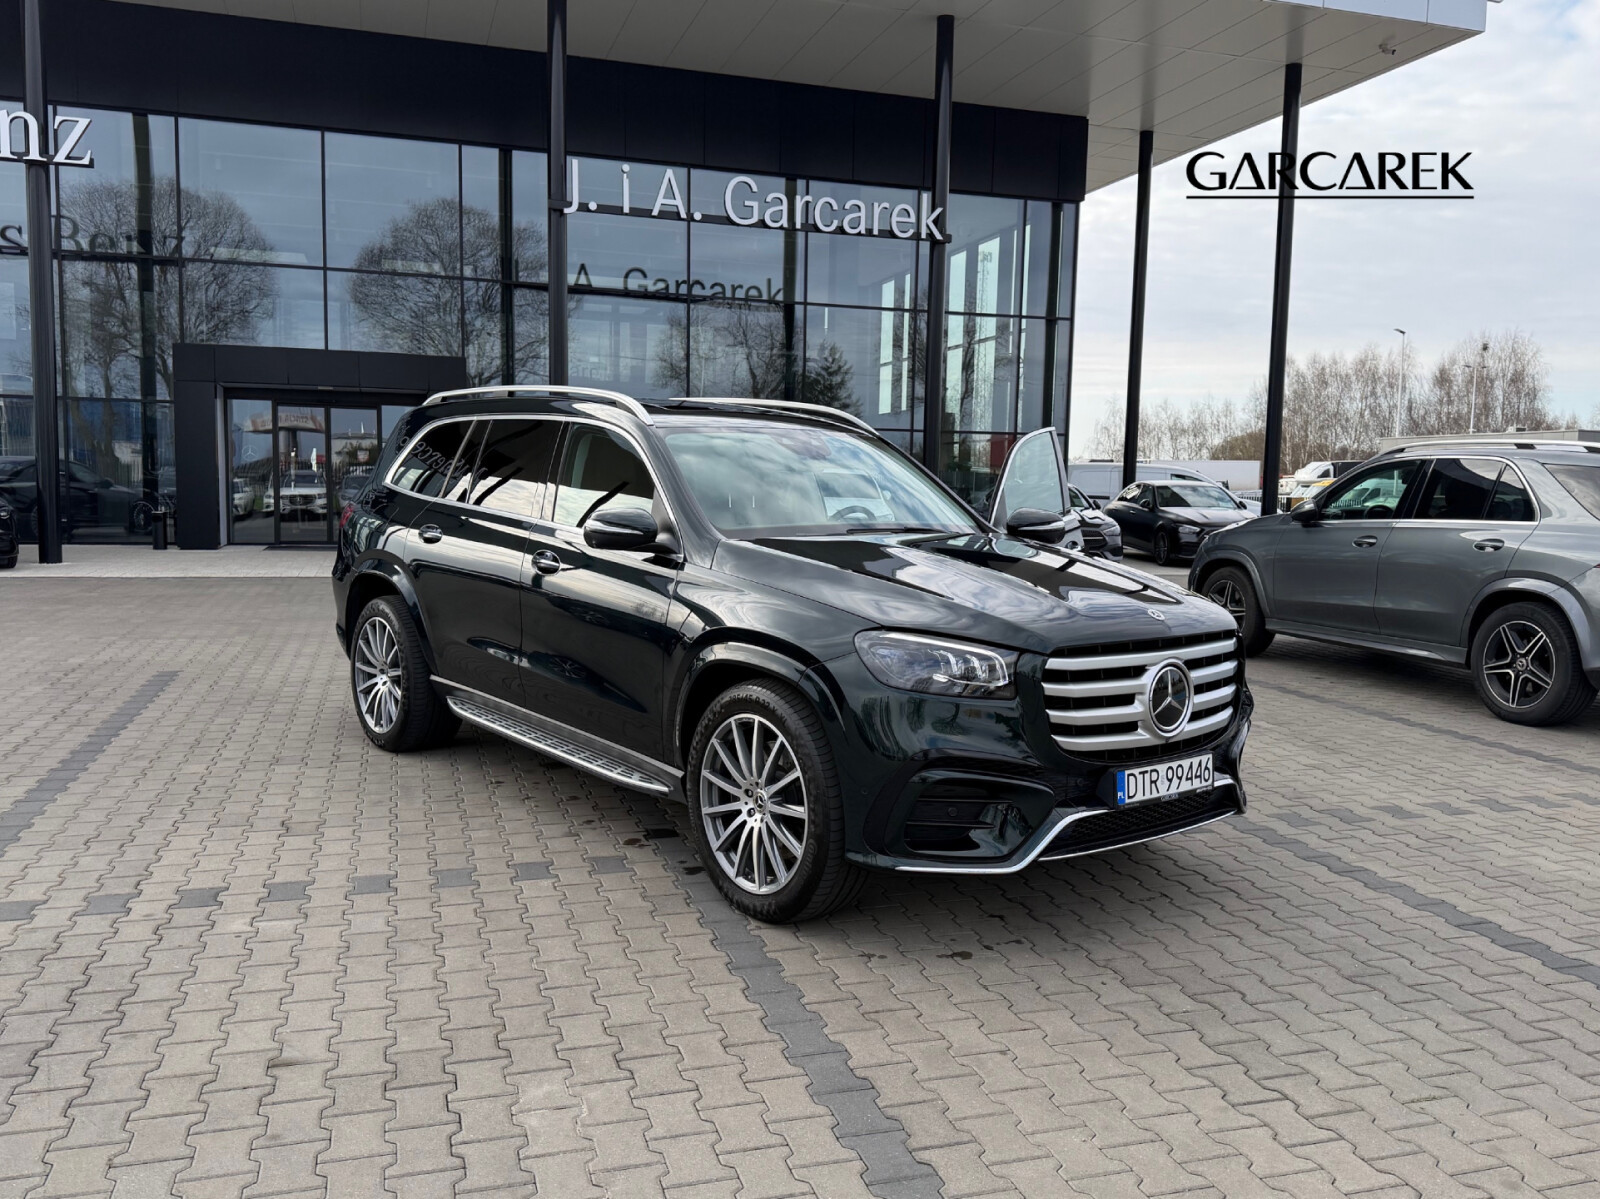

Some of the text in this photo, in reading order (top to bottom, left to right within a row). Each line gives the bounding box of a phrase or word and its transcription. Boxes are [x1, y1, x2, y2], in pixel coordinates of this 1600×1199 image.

[621, 163, 630, 214] i
[651, 168, 702, 221] A.
[724, 175, 944, 240] Garcarek
[1118, 792, 1125, 800] PL
[1127, 757, 1211, 800] DTR 99446
